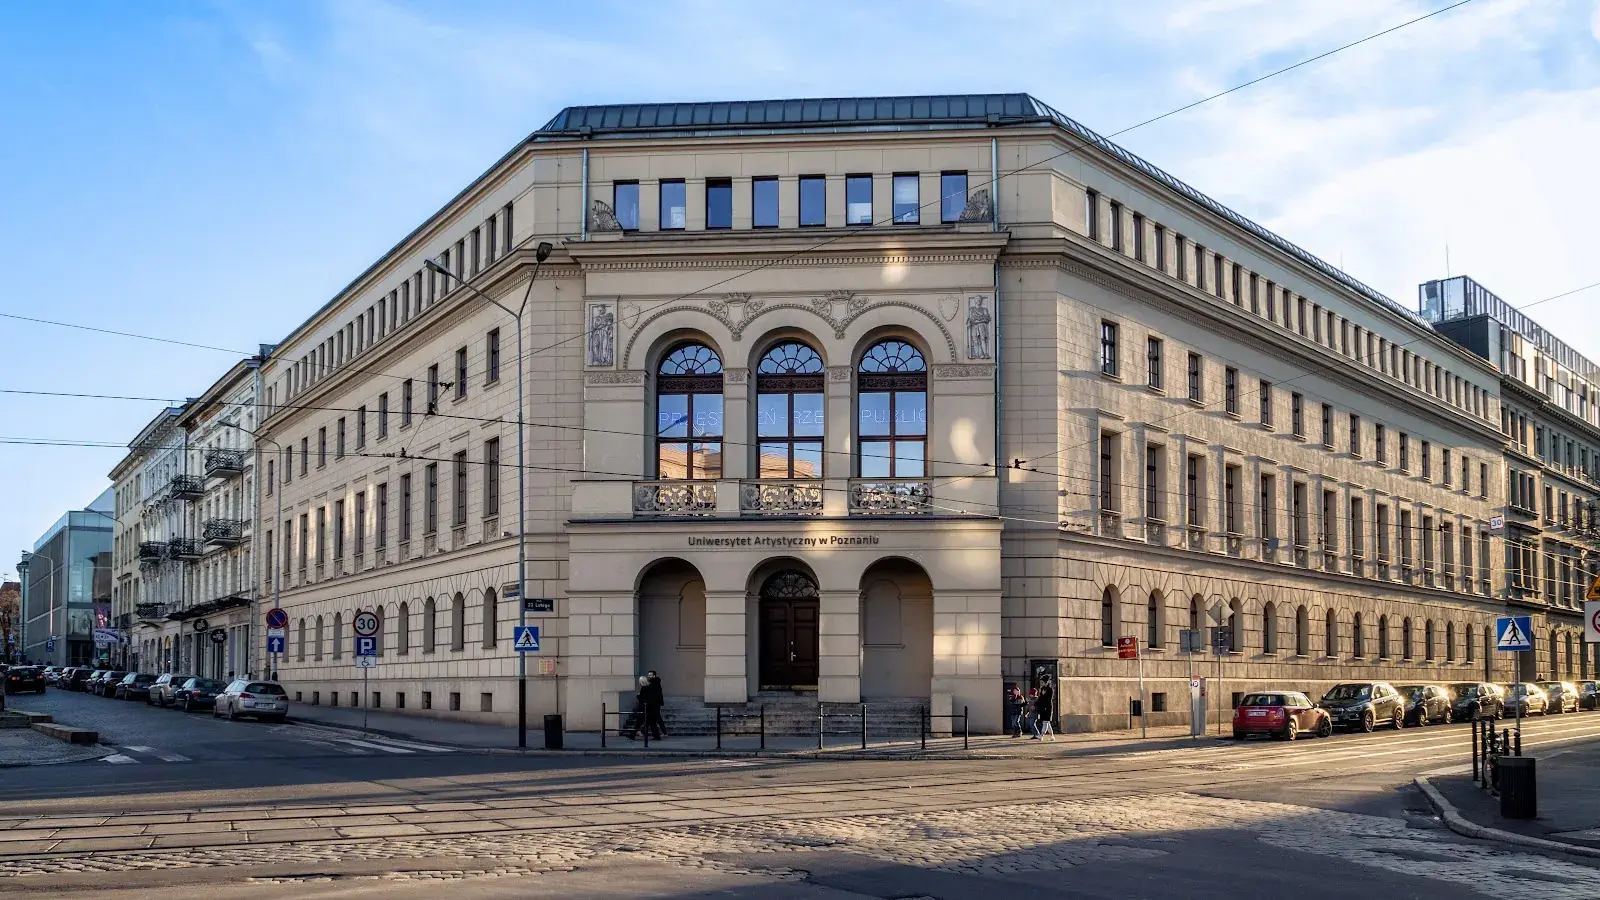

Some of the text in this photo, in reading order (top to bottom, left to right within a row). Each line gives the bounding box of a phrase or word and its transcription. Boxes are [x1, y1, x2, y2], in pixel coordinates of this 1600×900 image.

[688, 535, 879, 547] Uniwersytet Artystyczny w Poznaniu
[357, 618, 376, 630] 30
[360, 638, 373, 654] P
